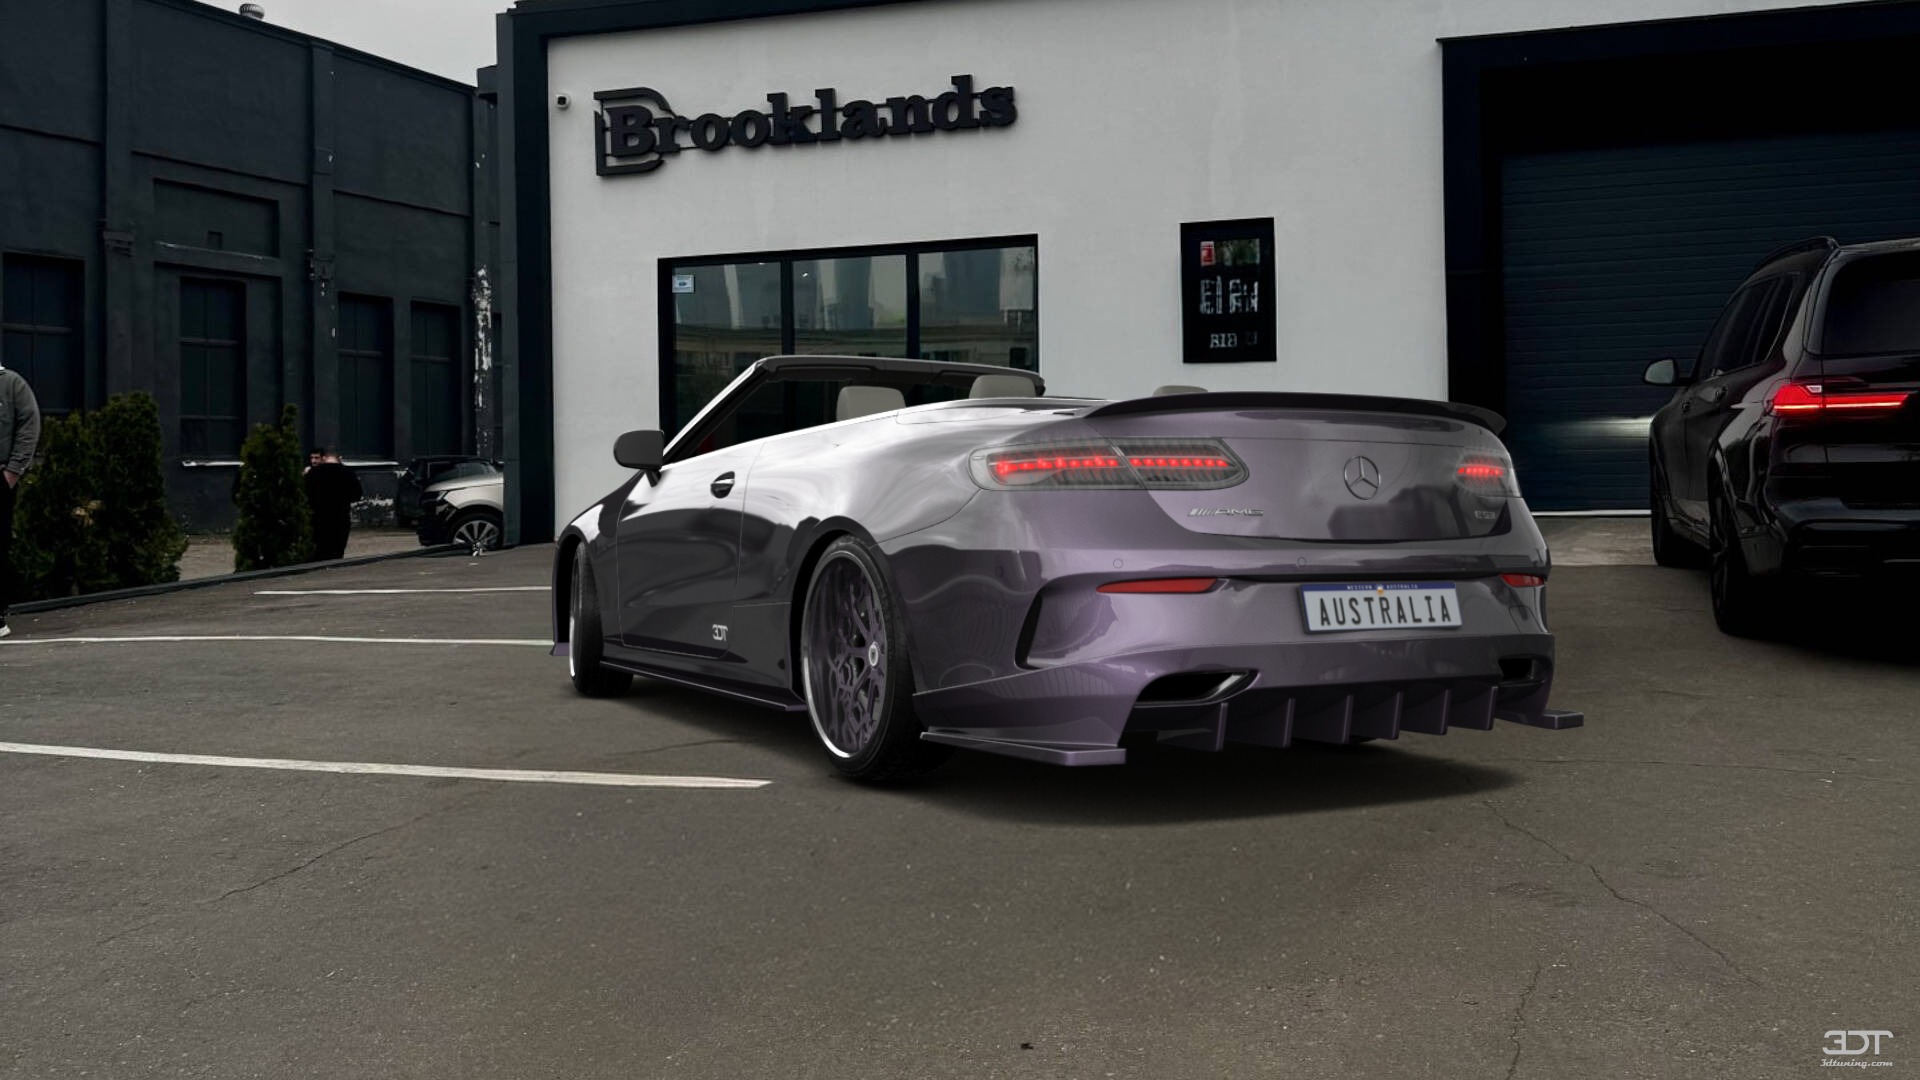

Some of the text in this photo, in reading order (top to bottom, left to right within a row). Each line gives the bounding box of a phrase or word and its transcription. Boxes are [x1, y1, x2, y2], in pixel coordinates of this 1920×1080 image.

[605, 74, 1018, 158] Brooklands
[1214, 508, 1264, 517] AMG
[1320, 595, 1452, 627] AUSTRALIA
[712, 624, 729, 641] 3DT
